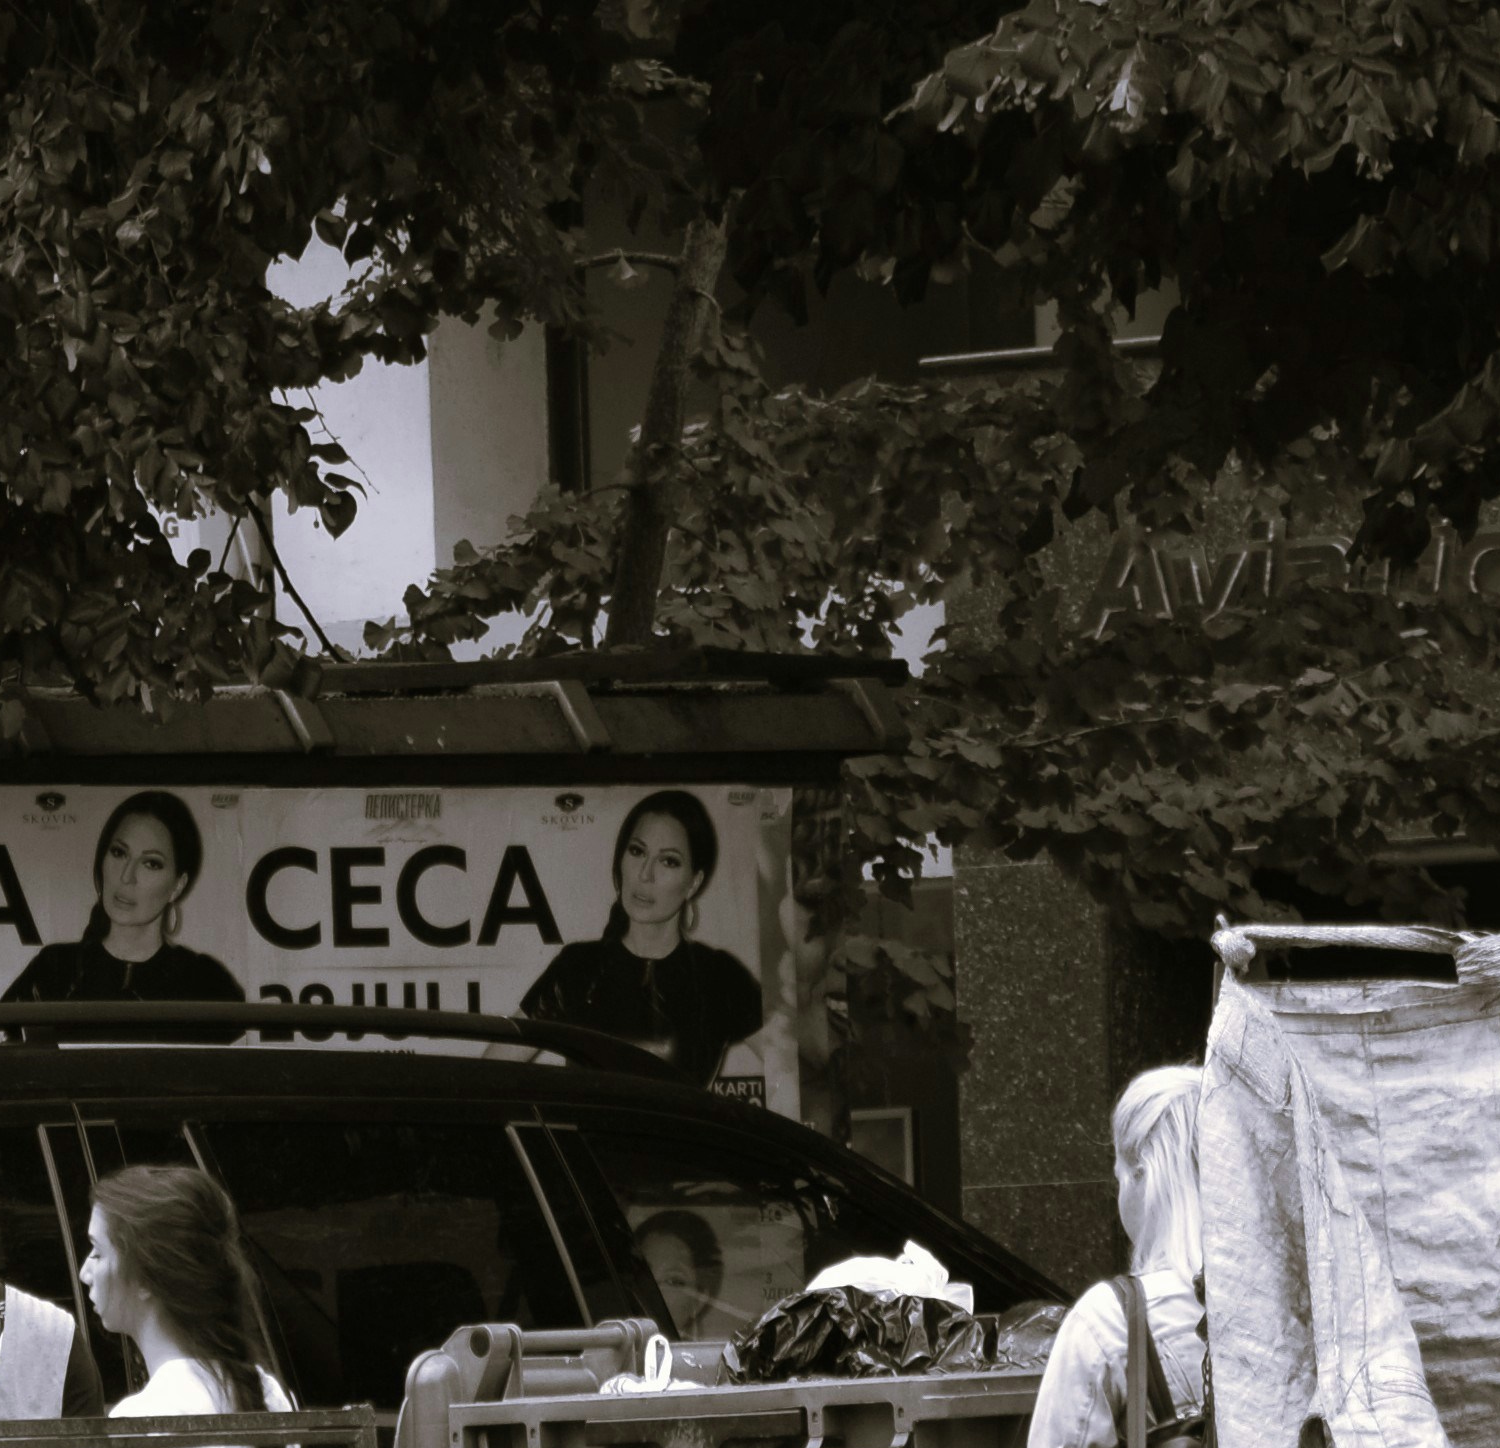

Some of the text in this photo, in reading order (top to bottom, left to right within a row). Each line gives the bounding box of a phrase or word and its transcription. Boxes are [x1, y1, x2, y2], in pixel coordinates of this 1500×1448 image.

[22, 814, 77, 825] SKOVIN
[541, 814, 595, 826] SKOVIN
[246, 844, 564, 950] CECA
[714, 1081, 762, 1096] KARTI
